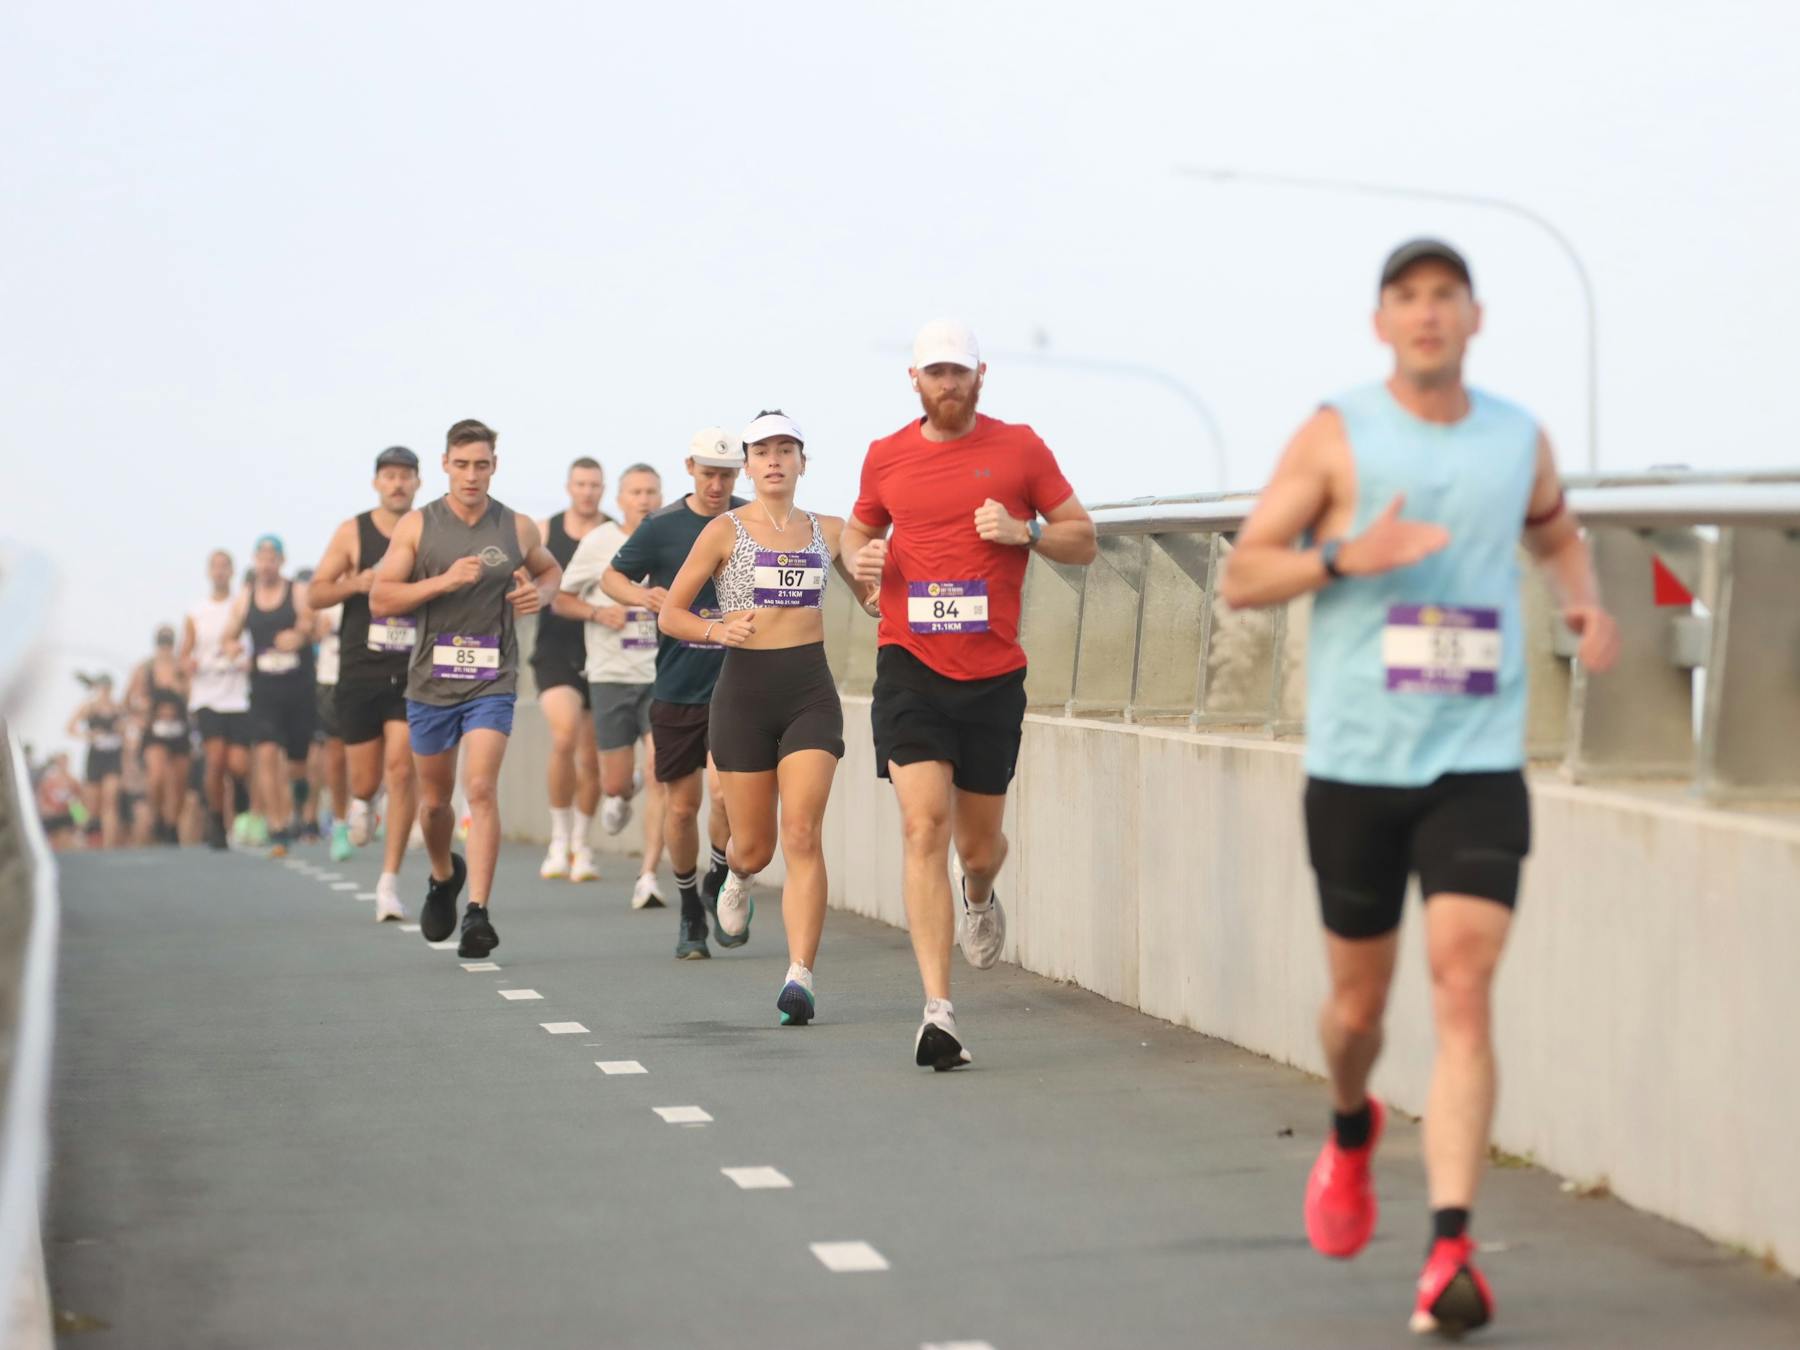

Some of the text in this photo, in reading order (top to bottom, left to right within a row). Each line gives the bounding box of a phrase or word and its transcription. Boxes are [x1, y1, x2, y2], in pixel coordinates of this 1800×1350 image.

[778, 569, 805, 587] 167
[933, 600, 959, 618] 84
[931, 623, 962, 631] 21.1KM
[456, 649, 475, 664] 85
